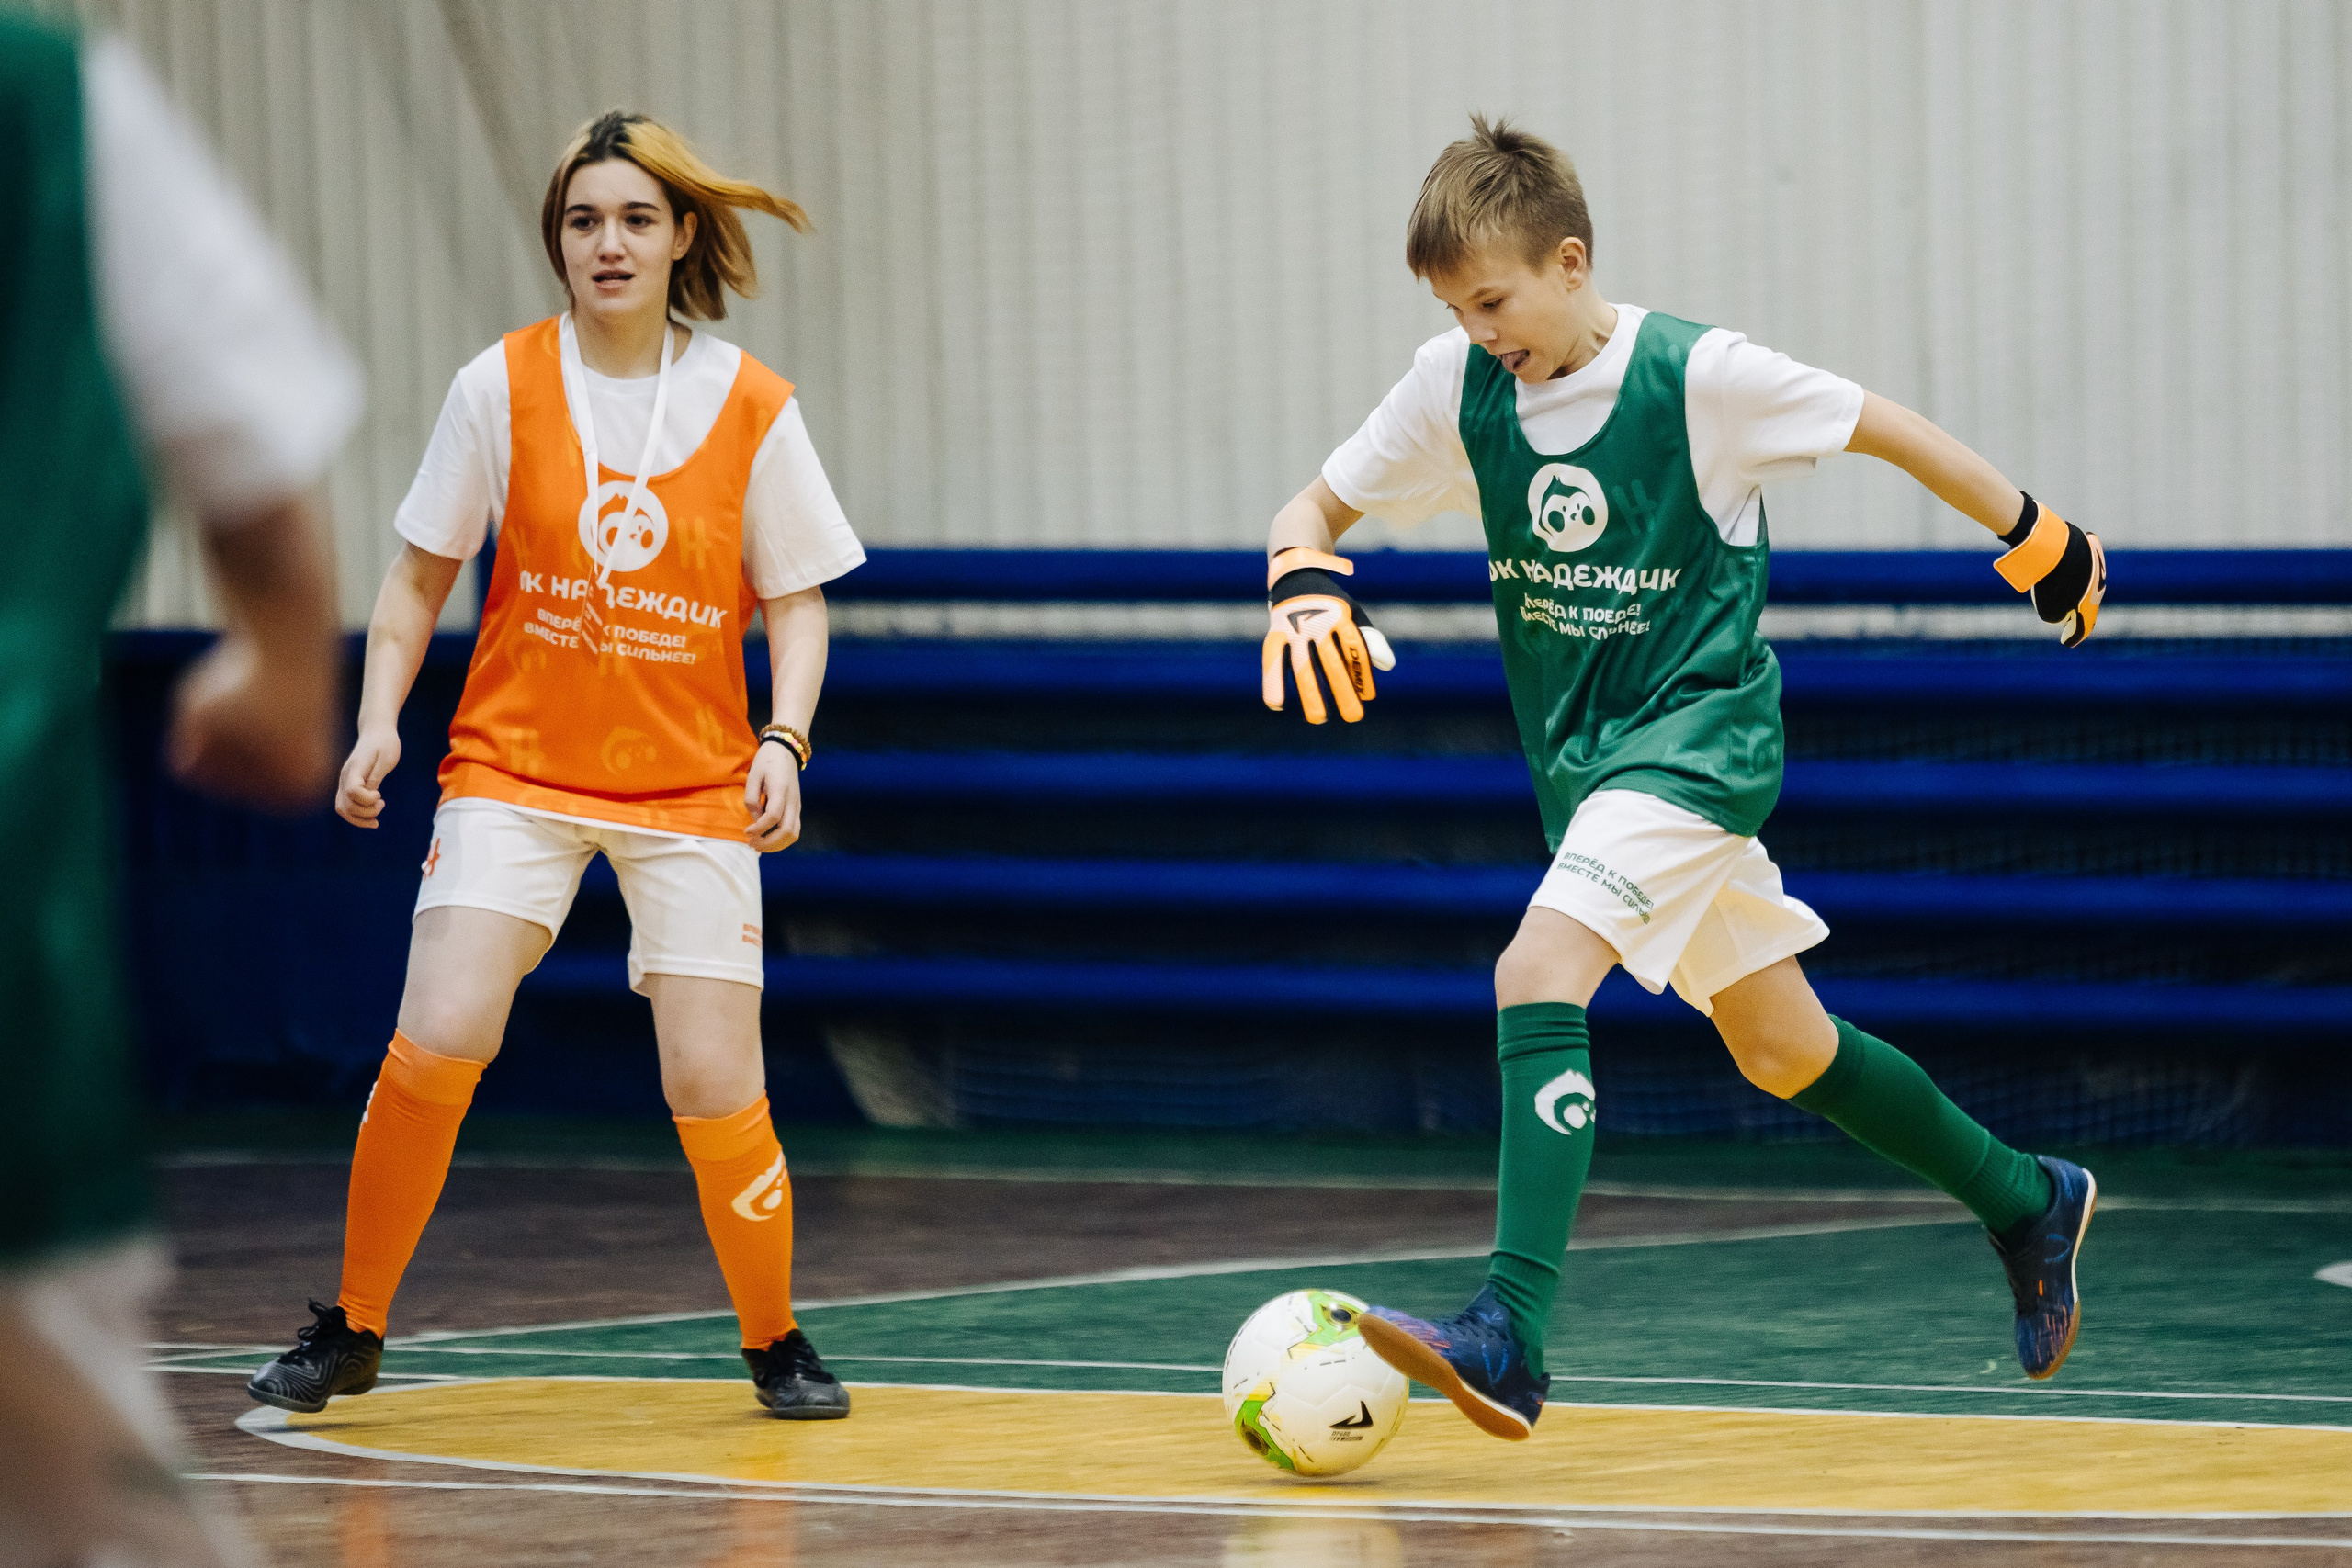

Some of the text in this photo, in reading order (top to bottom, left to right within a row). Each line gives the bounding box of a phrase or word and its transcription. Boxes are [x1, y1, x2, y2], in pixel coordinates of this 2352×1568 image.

[1519, 558, 1682, 596] НАДЕЖДИК
[537, 607, 582, 632] ВПЕРЁ
[614, 625, 686, 649] ПОБЕДЕ!
[1559, 622, 1586, 637] МЫ
[1568, 605, 1578, 620] К
[524, 622, 579, 649] ВМЕСТЕ
[616, 643, 696, 665] СИЛЬНЕЕ!
[1557, 862, 1600, 883] ВМЕСТЕ
[1601, 879, 1623, 897] МЫ
[1564, 852, 1655, 910] ВПЕРЁД К ПОБЕДЕ!
